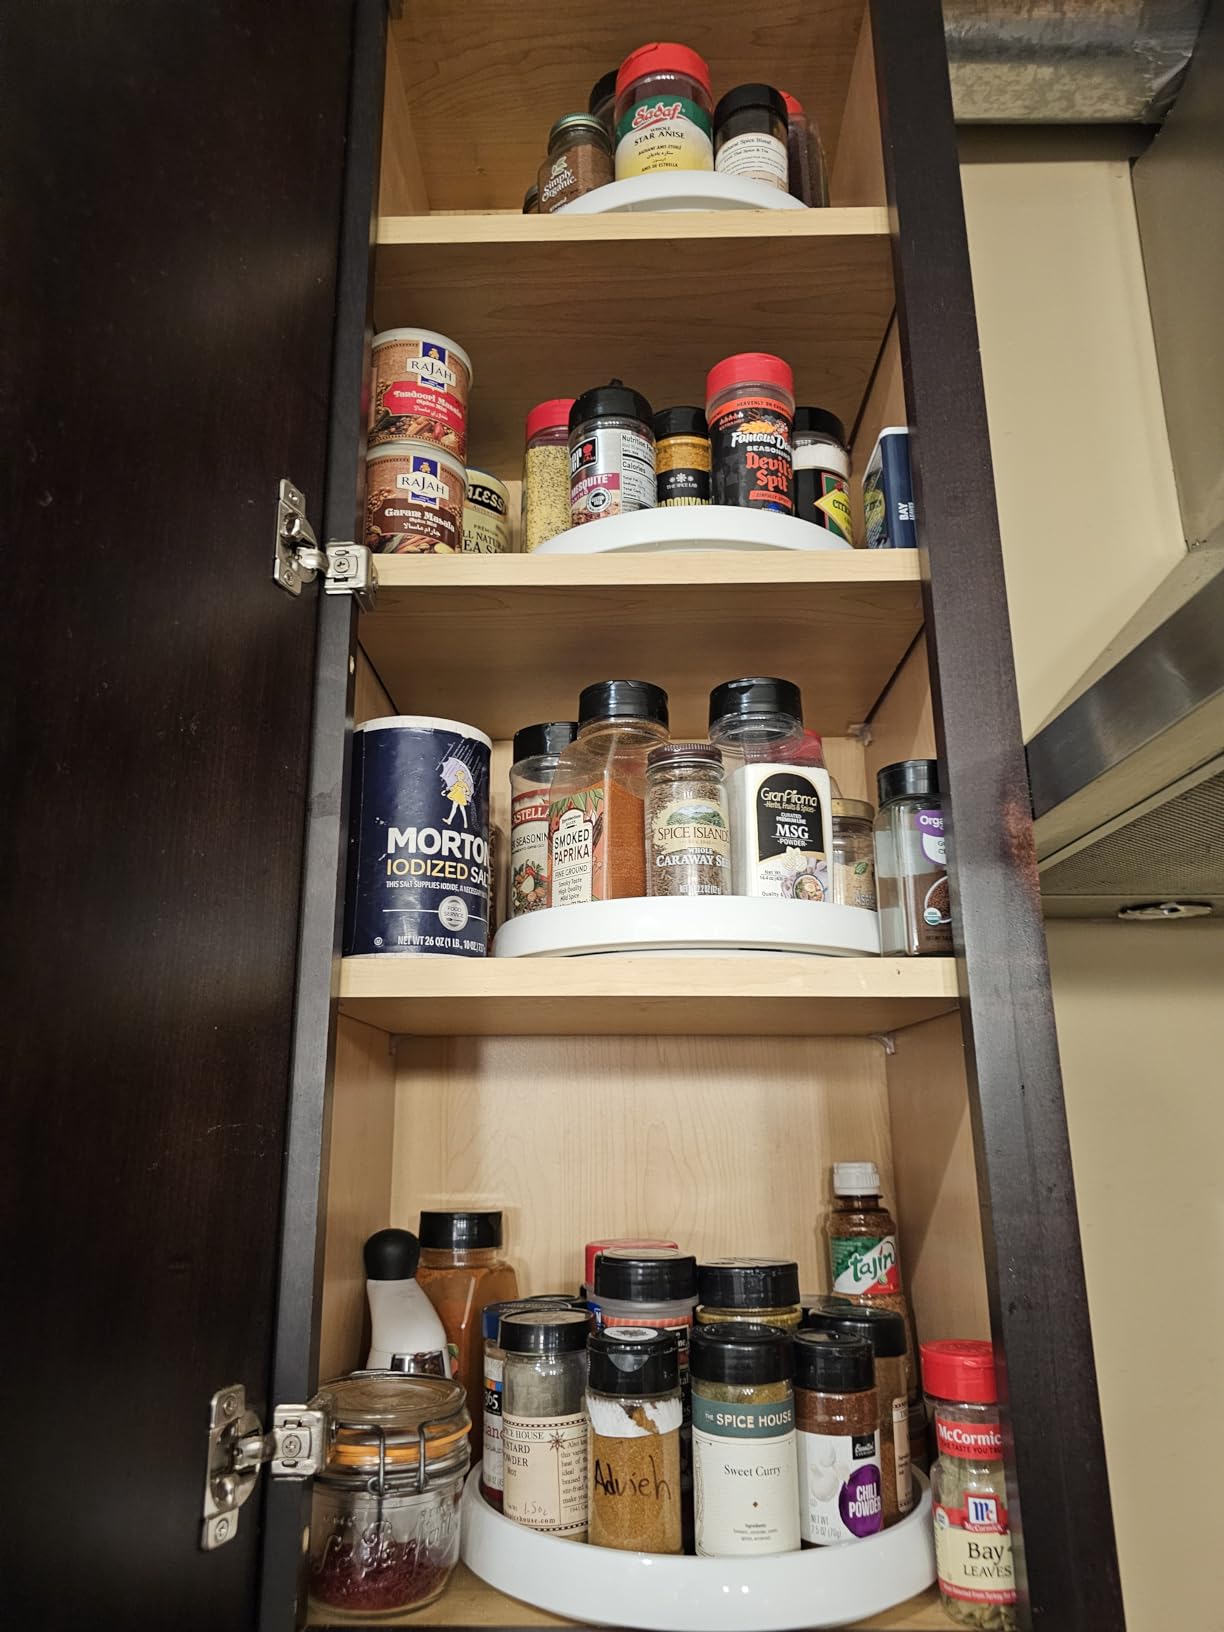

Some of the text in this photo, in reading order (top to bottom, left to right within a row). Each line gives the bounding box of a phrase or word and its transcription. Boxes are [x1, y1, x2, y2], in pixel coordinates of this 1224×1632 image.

[634, 131, 685, 146] STAR ANISE
[544, 169, 573, 192] Simply
[411, 360, 452, 382] RAJAH
[731, 431, 776, 448] Famous
[622, 461, 646, 474] Calories
[746, 452, 793, 480] Devil's
[402, 476, 445, 495] RAJAH
[756, 469, 788, 492] Spit
[384, 508, 422, 518] Garam
[423, 511, 455, 533] Masala
[898, 502, 909, 521] BAY
[463, 539, 481, 553] EA
[515, 832, 548, 848] SEASONIN
[554, 828, 590, 850] SMOKED
[658, 827, 691, 841] SPICE
[775, 823, 809, 839] MSG
[554, 844, 590, 867] PAPRIKA
[656, 854, 713, 867] CARAWAY
[386, 859, 469, 880] IODIZED
[470, 866, 490, 888] SAL
[554, 865, 588, 879] FINE GROUND
[386, 880, 399, 888] THIS
[399, 880, 414, 888] SALT
[414, 881, 440, 889] SUPPLIES
[443, 911, 465, 919] SERVICE
[397, 935, 413, 945] NET
[413, 935, 424, 945] WT
[424, 936, 434, 946] 26
[435, 937, 444, 946] OZ
[704, 1409, 793, 1429] THE SPICE HOUSE
[515, 1430, 544, 1440] HOUSE
[938, 1423, 1002, 1446] McCormic
[503, 1442, 531, 1454] STARD
[951, 1442, 970, 1453] TASTE
[974, 1445, 988, 1454] YOU
[592, 1453, 672, 1500] Advieh
[724, 1464, 782, 1478] Sweet Curry
[856, 1482, 877, 1502] CHILI
[848, 1496, 882, 1519] POWDER
[967, 1541, 1004, 1566] Bay
[963, 1564, 1012, 1578] LEAVES
